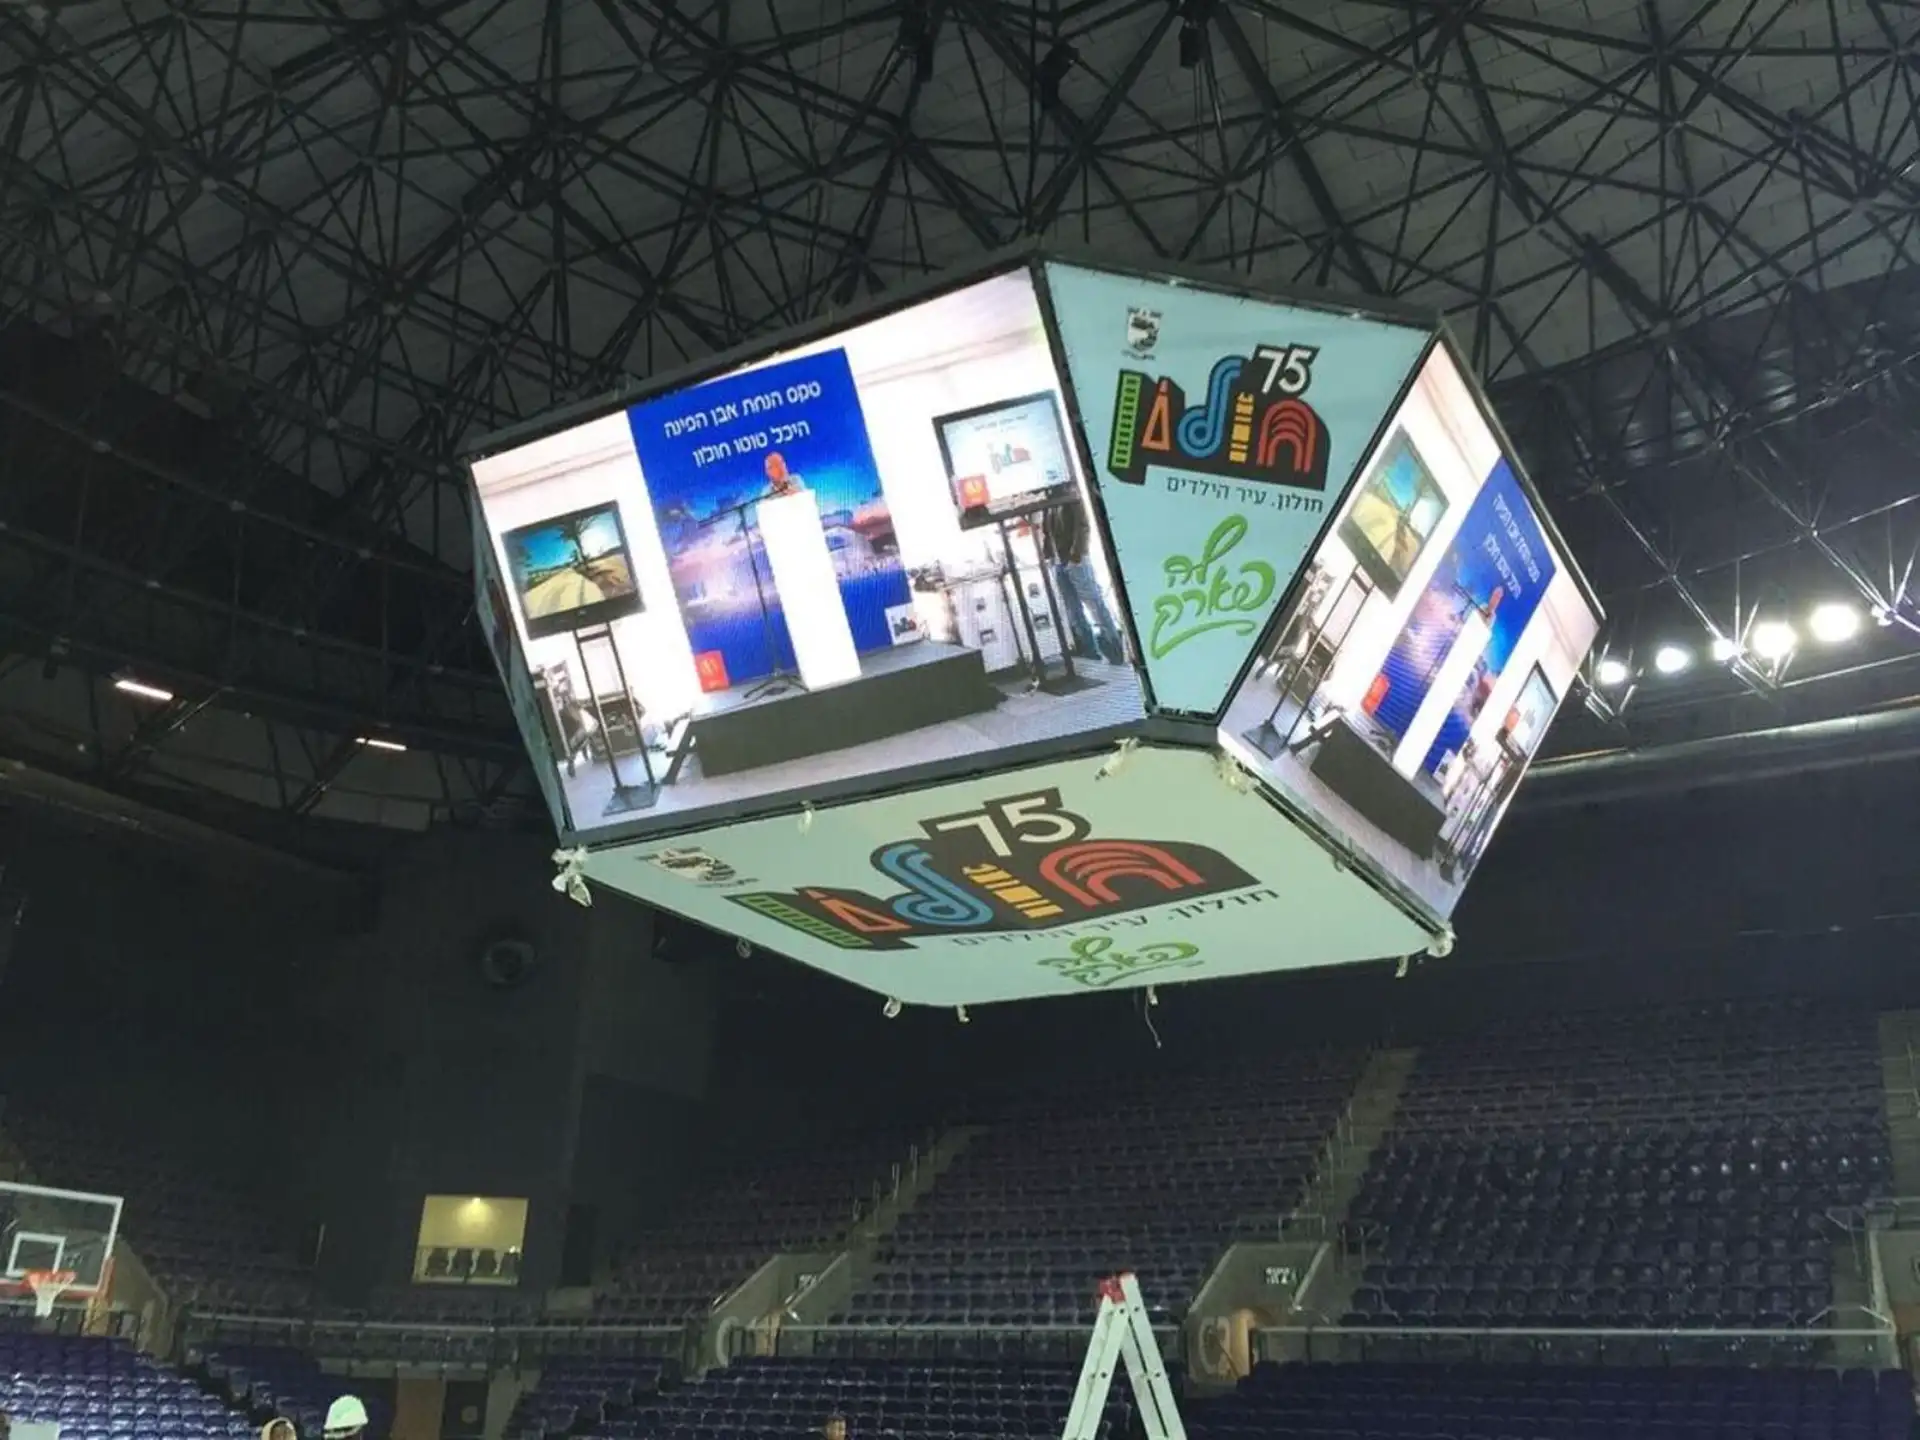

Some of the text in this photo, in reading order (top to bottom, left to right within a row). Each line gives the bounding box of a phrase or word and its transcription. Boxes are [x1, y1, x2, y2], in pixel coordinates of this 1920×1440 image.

[1257, 347, 1312, 395] 75
[664, 381, 822, 438] טקס הנחת אבן הפינה
[692, 420, 811, 468] היכל טוטו חולון
[1166, 476, 1324, 513] חולון. עיר הילדים
[935, 795, 1077, 858] 75
